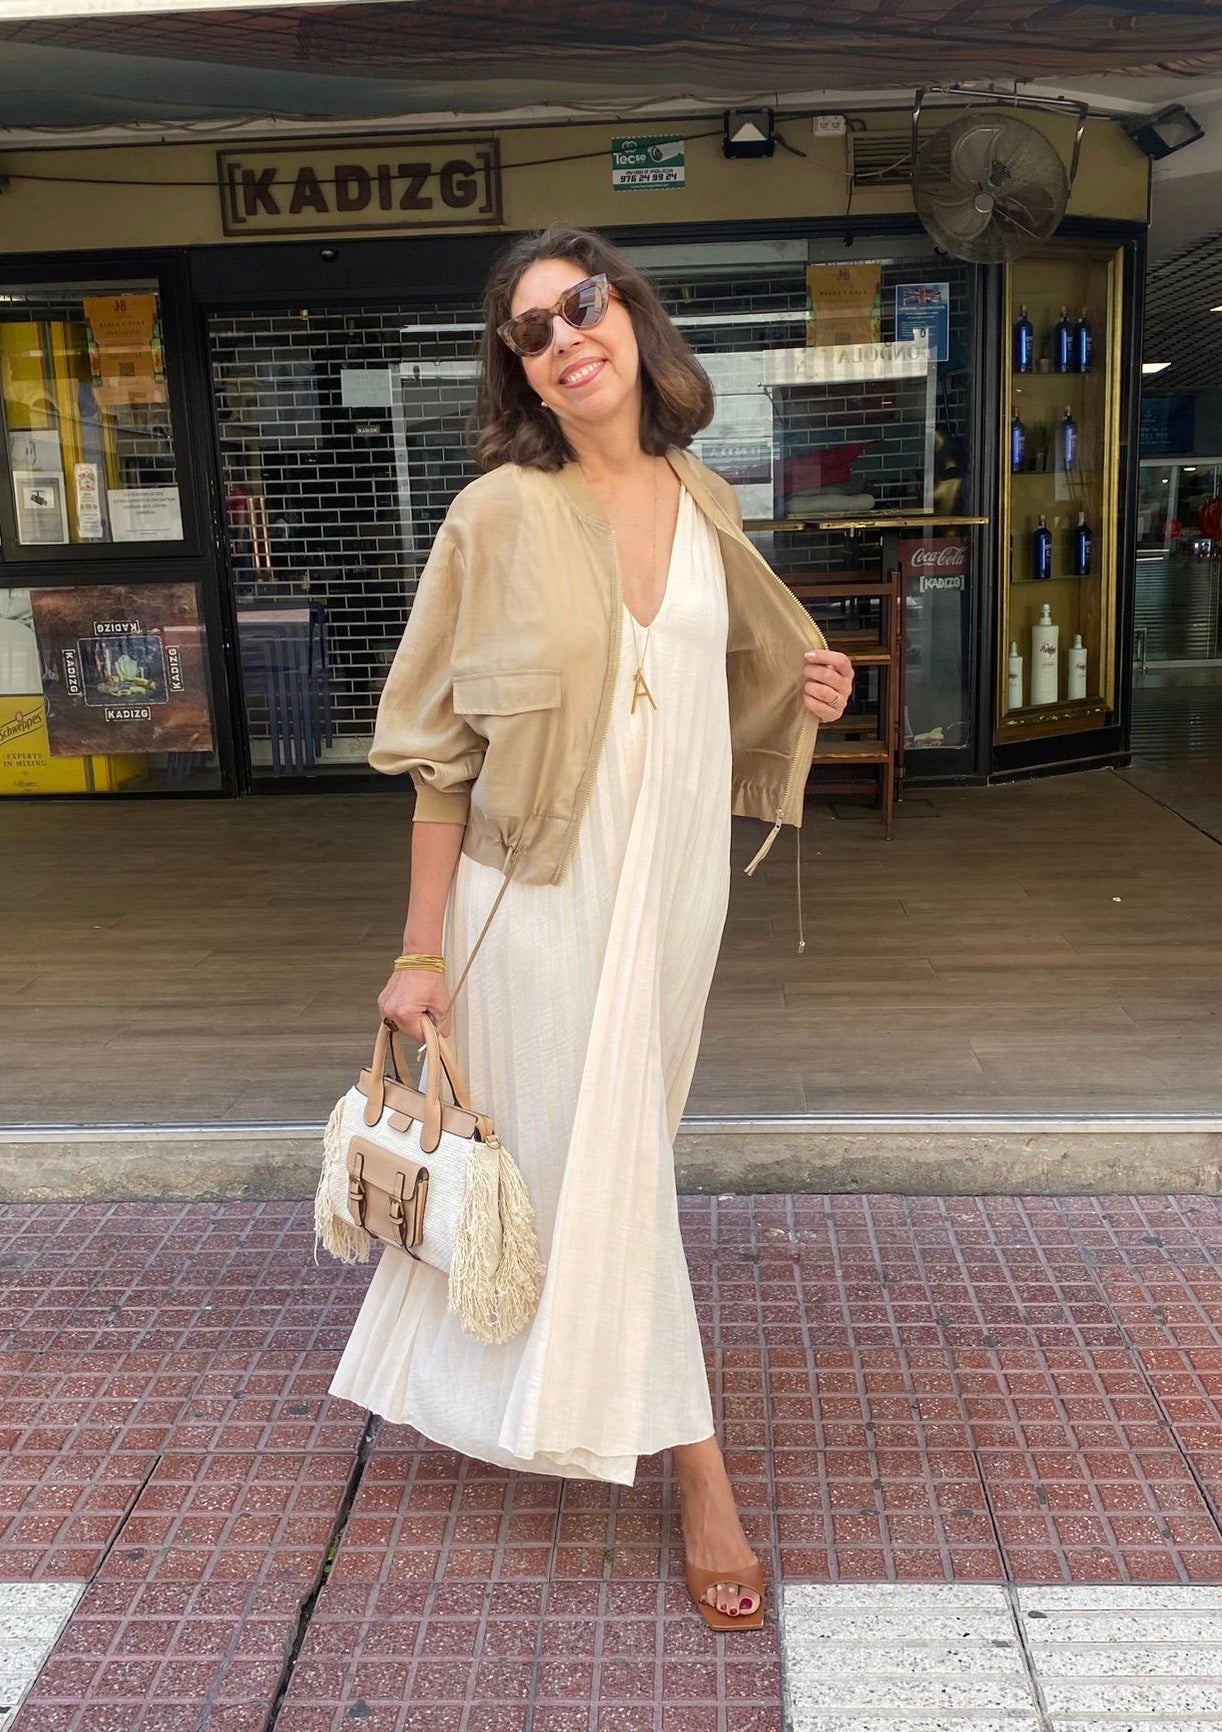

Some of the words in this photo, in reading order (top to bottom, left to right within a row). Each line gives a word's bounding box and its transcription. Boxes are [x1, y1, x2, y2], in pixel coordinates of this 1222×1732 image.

[620, 174, 637, 183] 976
[638, 174, 650, 182] 24
[652, 173, 664, 181] 99
[665, 172, 677, 181] 24
